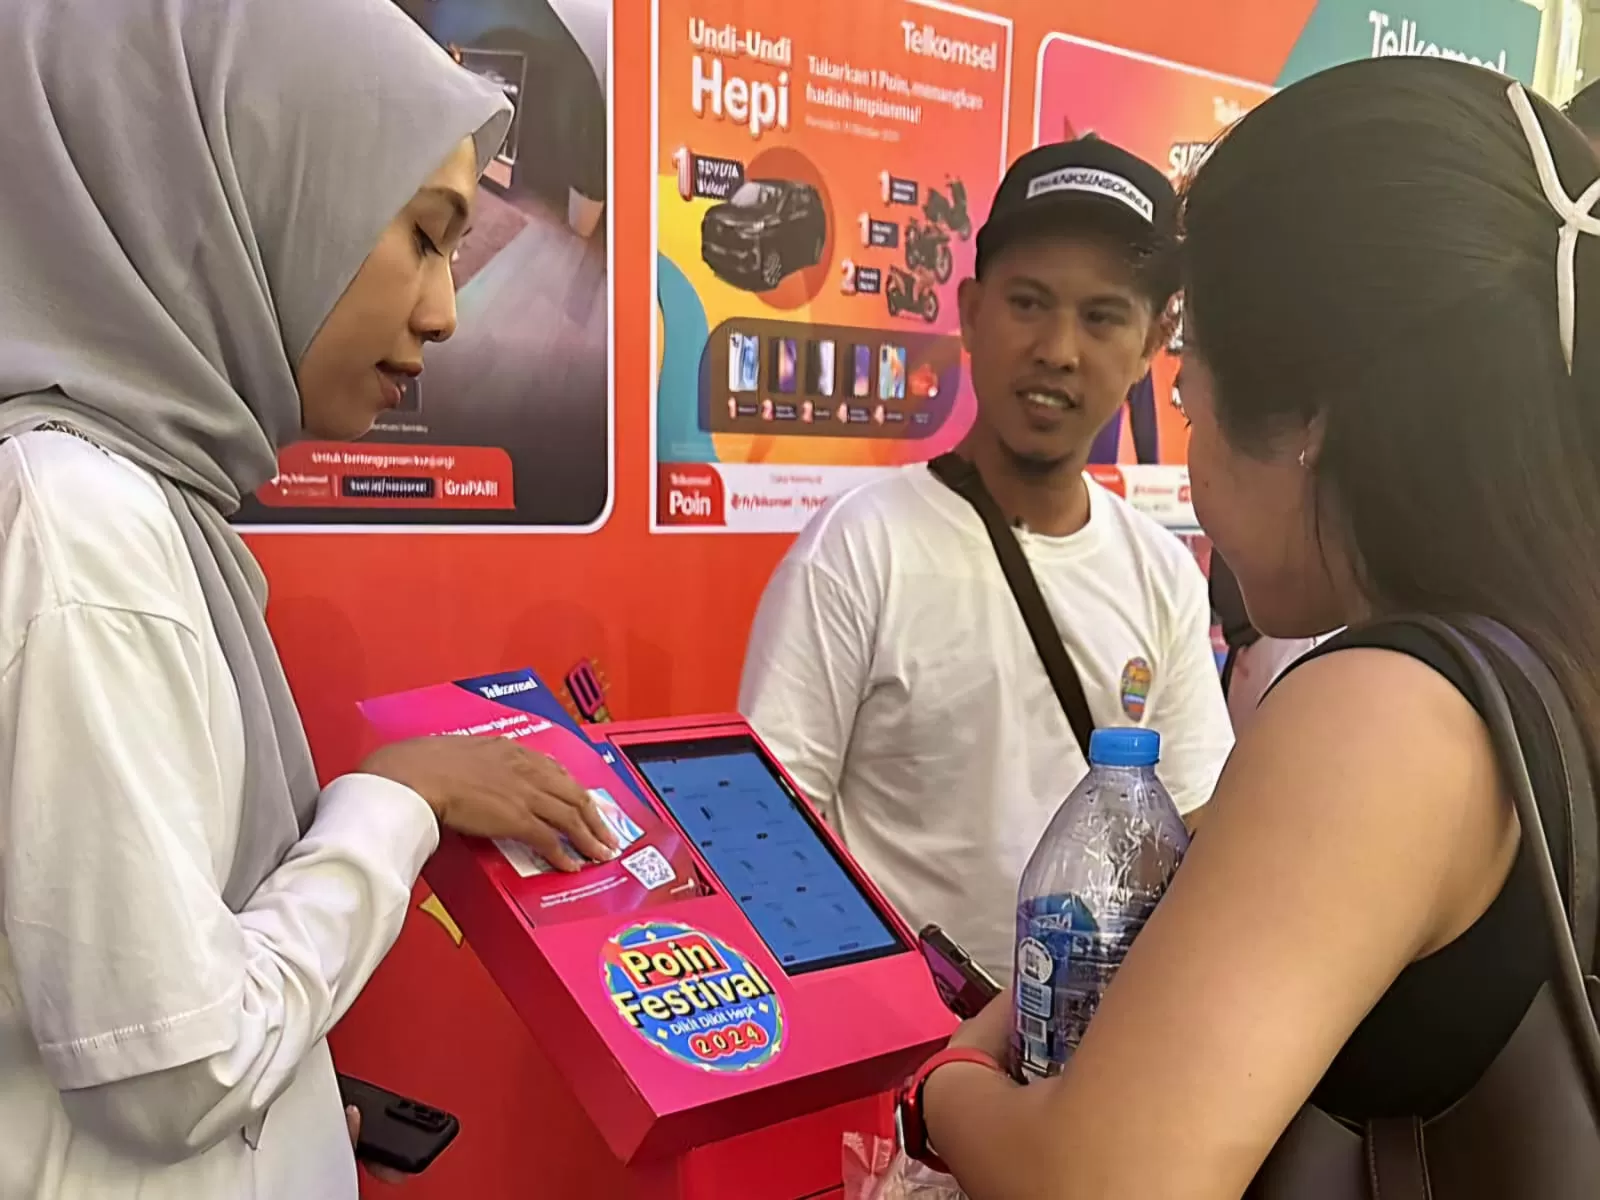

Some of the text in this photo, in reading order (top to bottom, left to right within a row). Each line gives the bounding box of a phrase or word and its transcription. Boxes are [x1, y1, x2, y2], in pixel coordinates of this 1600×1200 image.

[688, 17, 791, 62] Undi-Undi
[901, 20, 997, 71] Telkomsel
[1369, 10, 1505, 73] Telkol
[692, 55, 788, 136] Hepi
[673, 146, 690, 198] 1
[879, 169, 890, 203] 1
[858, 212, 869, 246] 1
[841, 257, 855, 293] 2
[669, 489, 711, 516] Poin
[620, 940, 718, 983] Poin
[611, 961, 772, 1027] Festival
[695, 1025, 762, 1054] 2024
